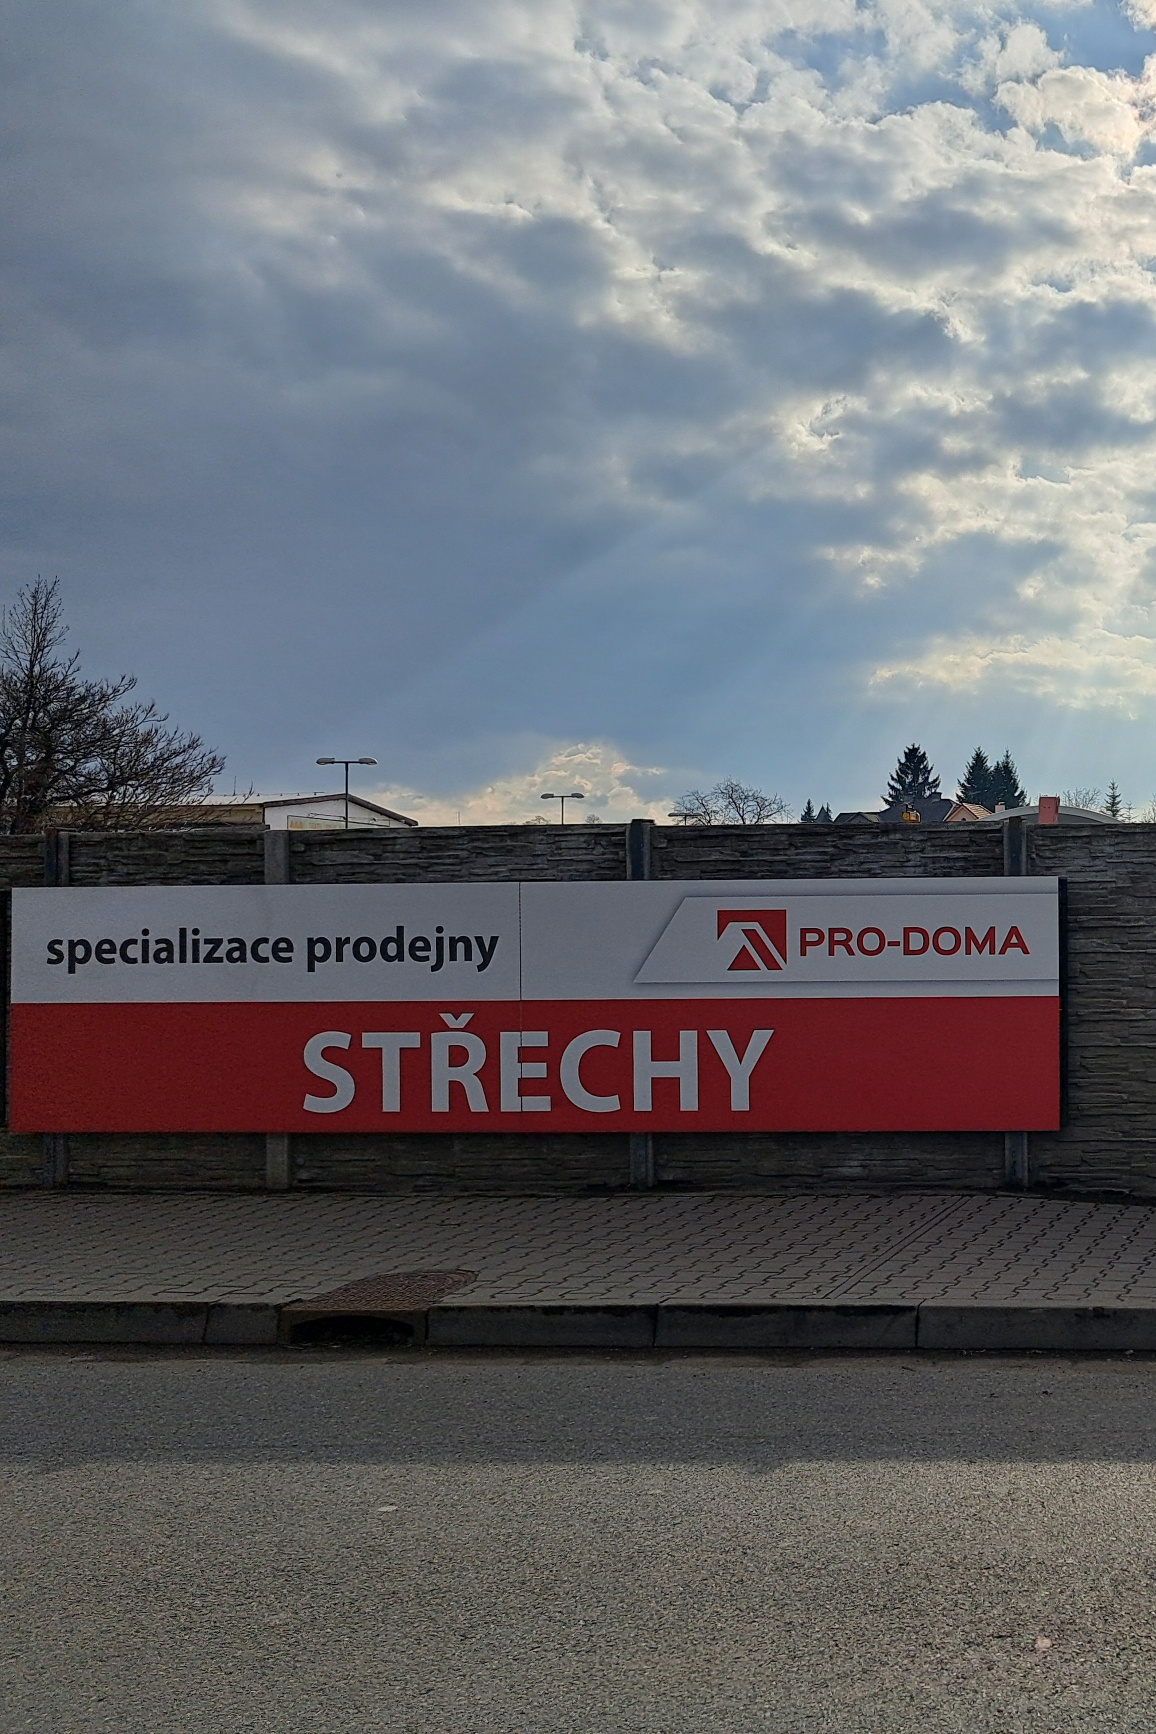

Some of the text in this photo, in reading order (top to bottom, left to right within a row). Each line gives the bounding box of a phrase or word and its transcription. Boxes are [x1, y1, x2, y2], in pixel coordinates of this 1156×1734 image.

[46, 925, 499, 974] specializace prodejny
[799, 925, 1030, 957] PRO-DOMA
[302, 1012, 774, 1114] STŘECHY
